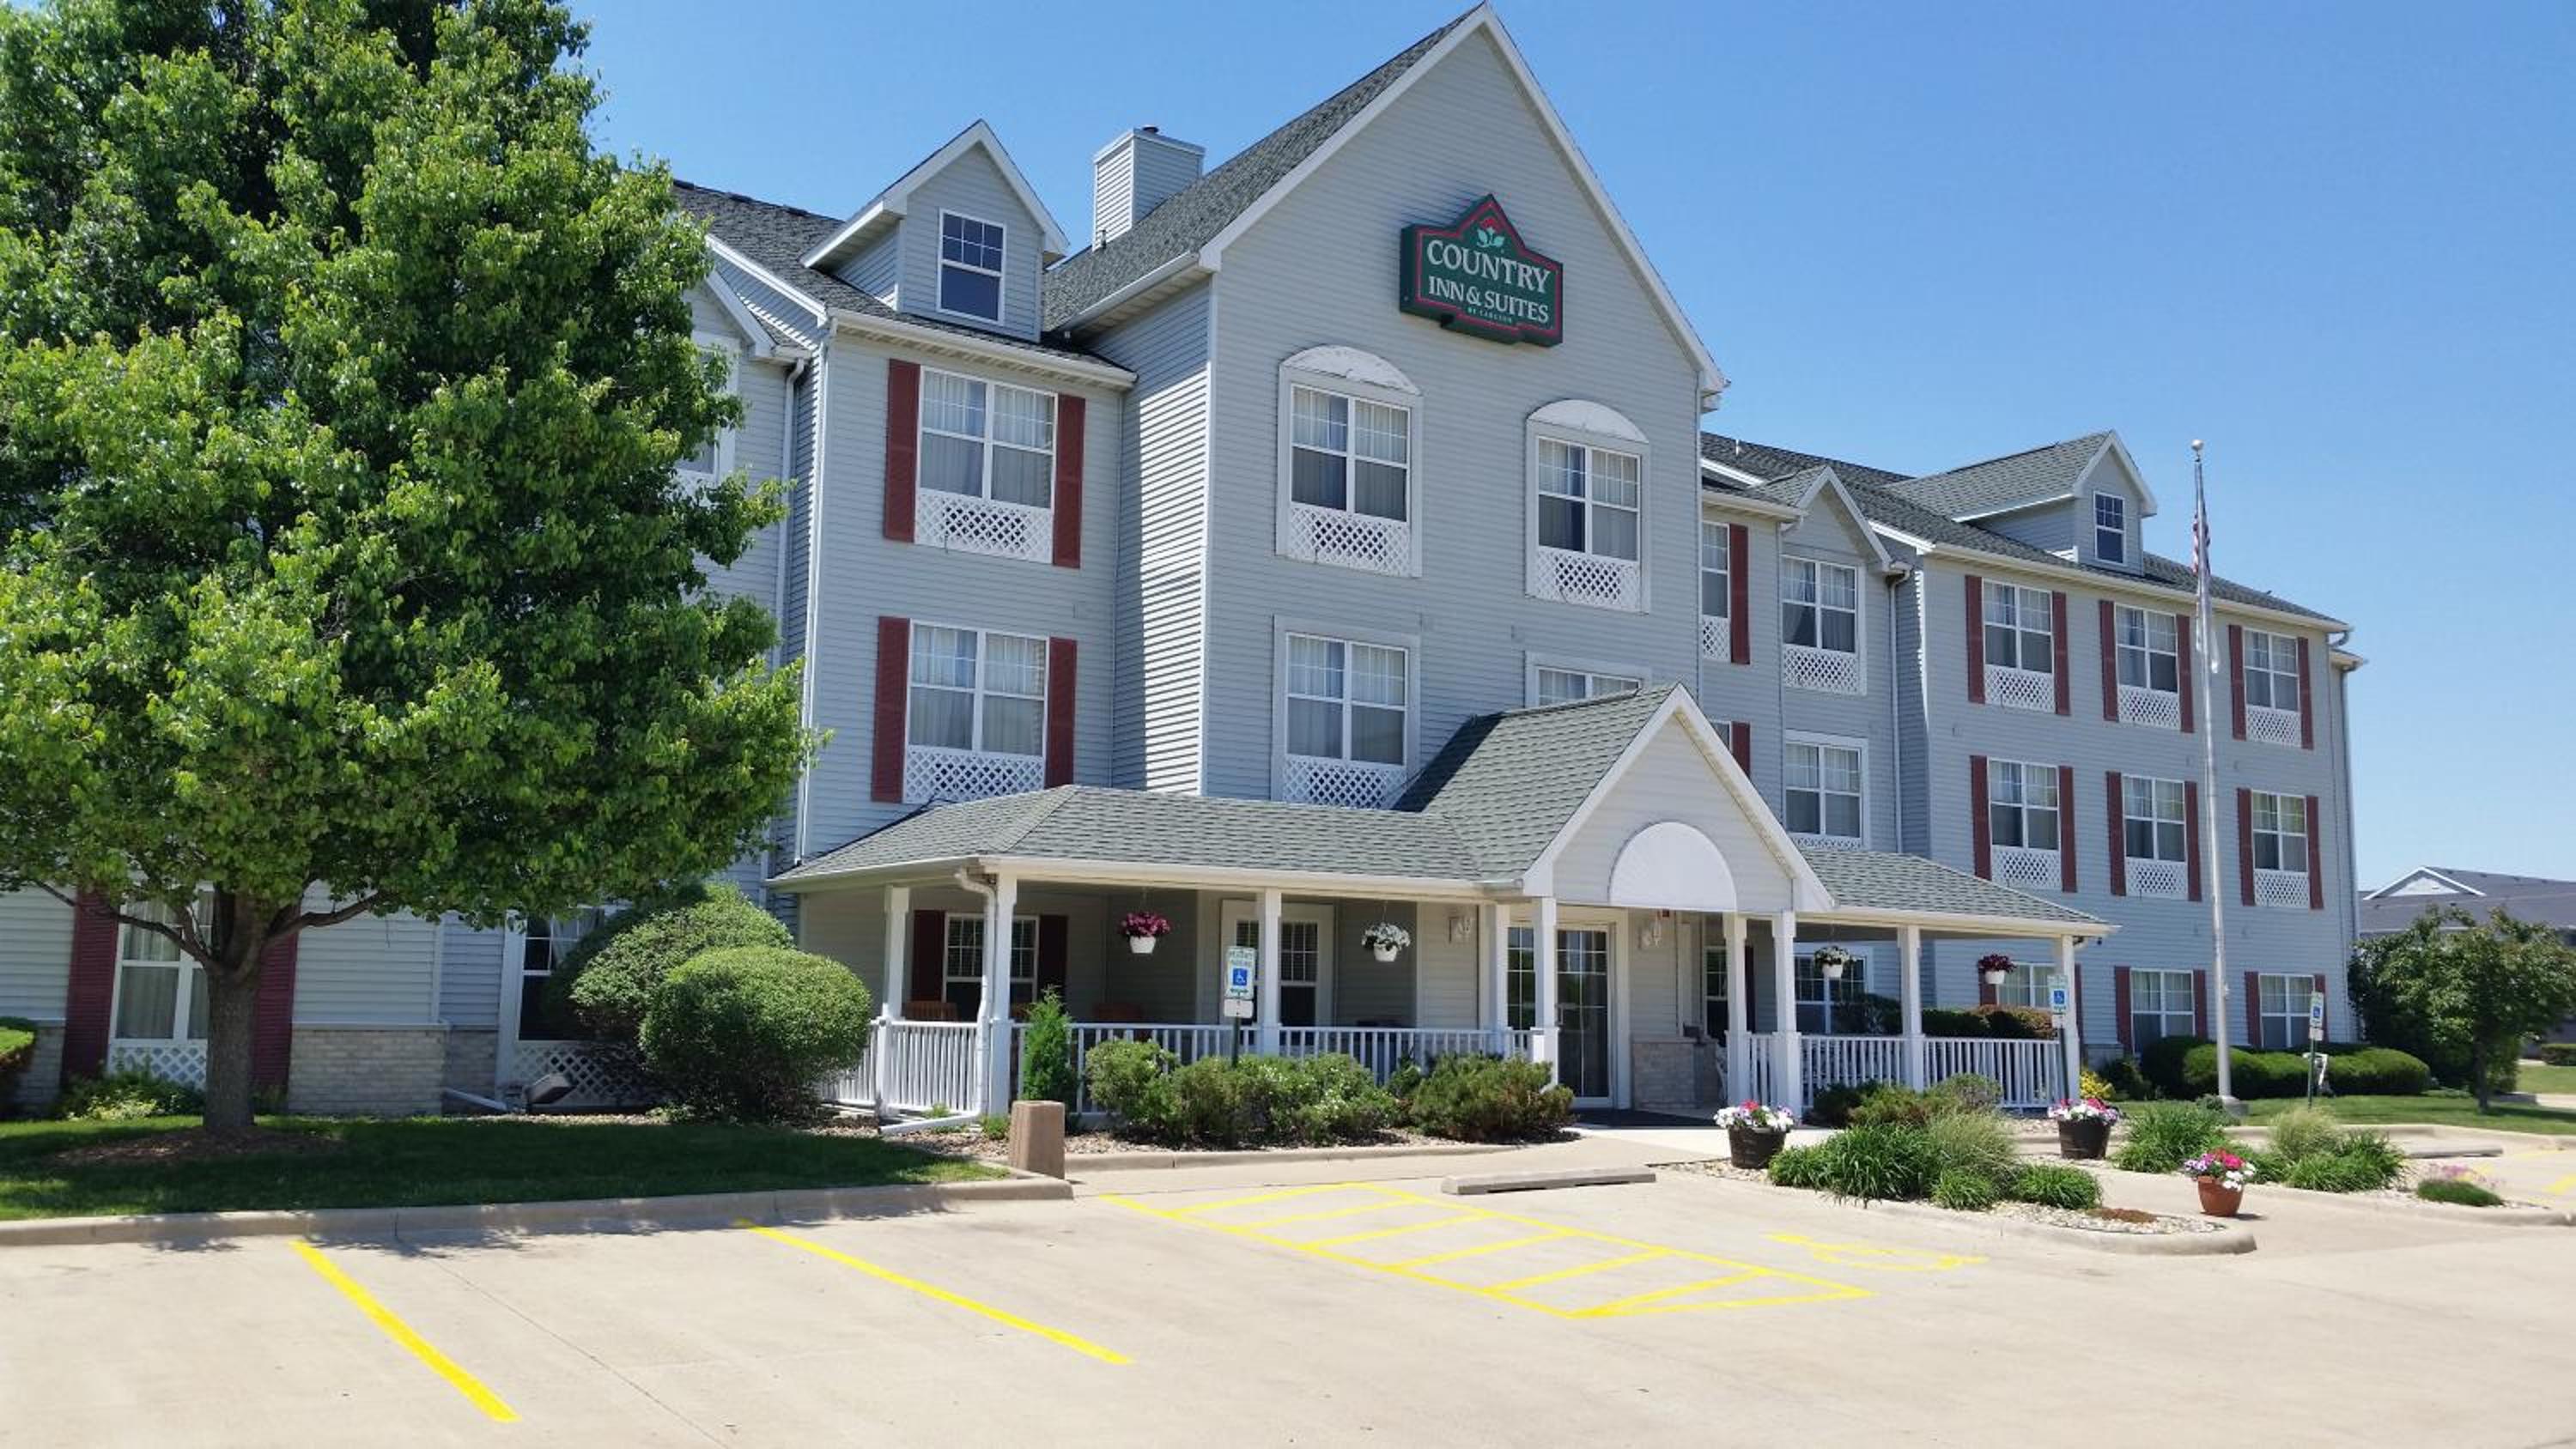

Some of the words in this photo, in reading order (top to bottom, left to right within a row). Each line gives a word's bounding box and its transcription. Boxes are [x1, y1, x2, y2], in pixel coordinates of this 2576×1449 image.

[1427, 239, 1551, 294] COUNTRY
[1428, 276, 1465, 302] INN
[1466, 286, 1481, 306] &
[1485, 291, 1549, 323] SUITES
